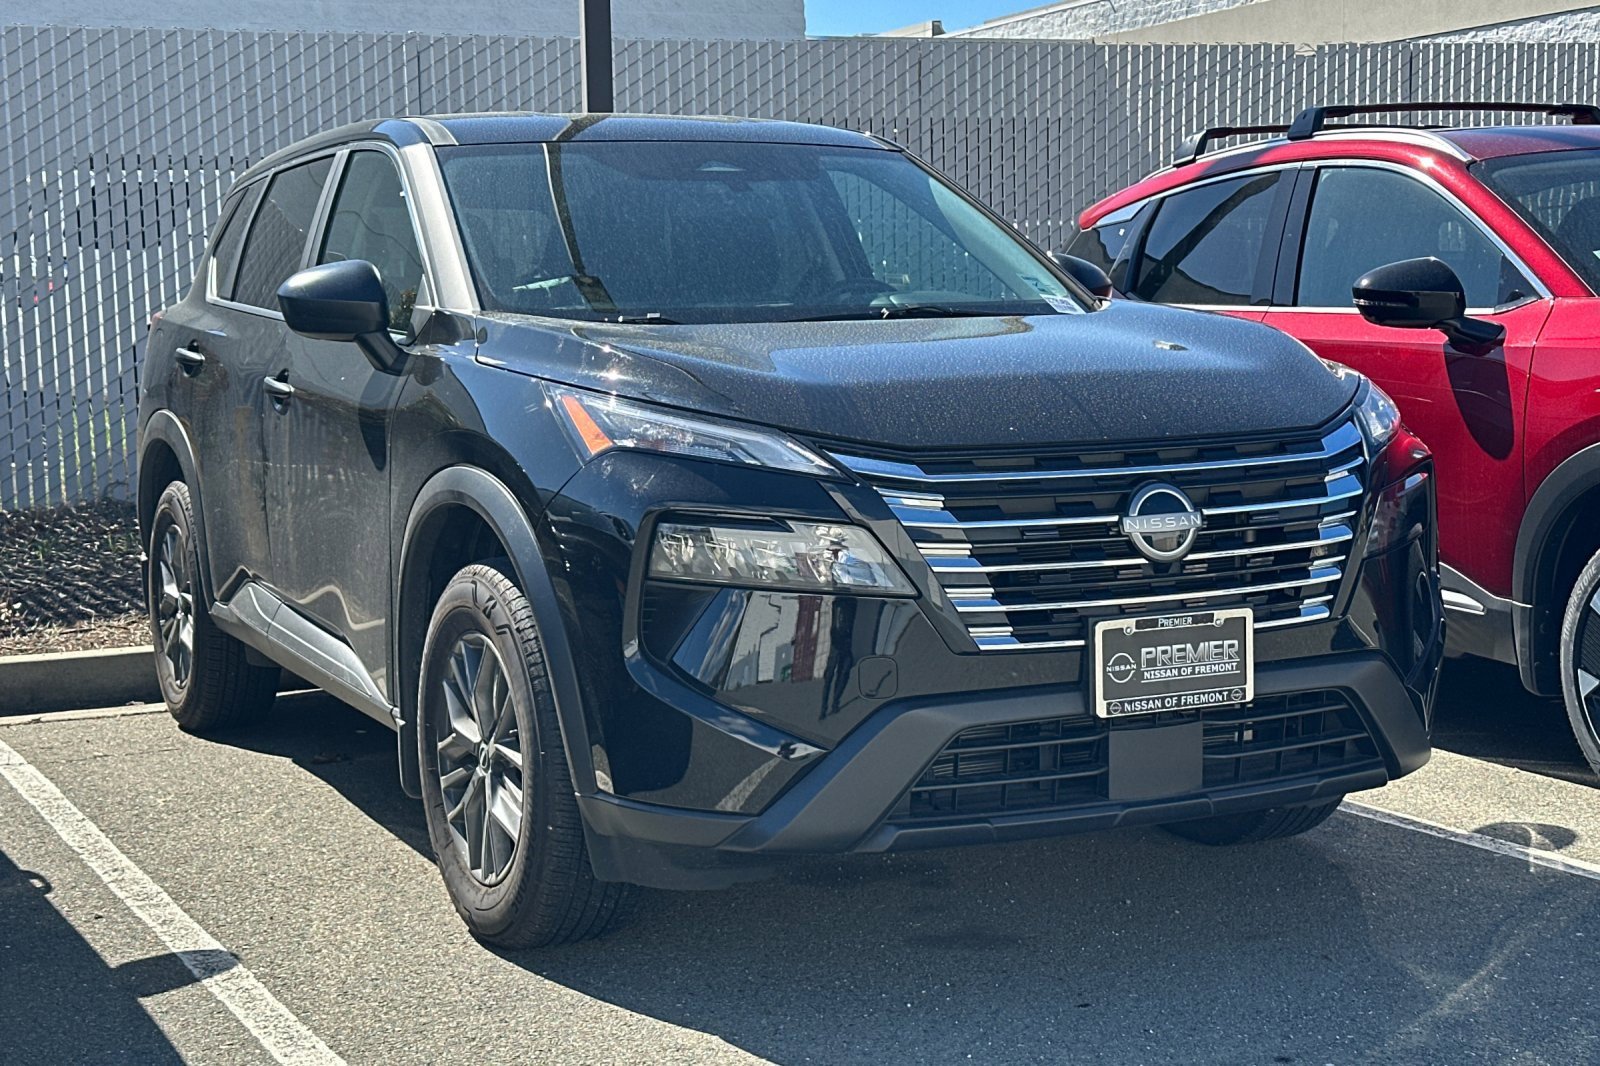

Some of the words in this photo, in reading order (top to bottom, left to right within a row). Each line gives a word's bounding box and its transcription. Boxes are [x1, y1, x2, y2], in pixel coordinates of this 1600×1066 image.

[1126, 514, 1200, 530] NISSAN
[1158, 617, 1192, 627] PREMIER
[1141, 640, 1239, 668] PREMIER
[1106, 663, 1136, 672] NISSAN
[1144, 668, 1178, 679] NISSAN
[1181, 666, 1192, 675] OF
[1195, 662, 1237, 674] FREMONT
[1125, 702, 1161, 711] NISSAN
[1165, 698, 1177, 707] OF
[1181, 692, 1228, 705] FREMONT
